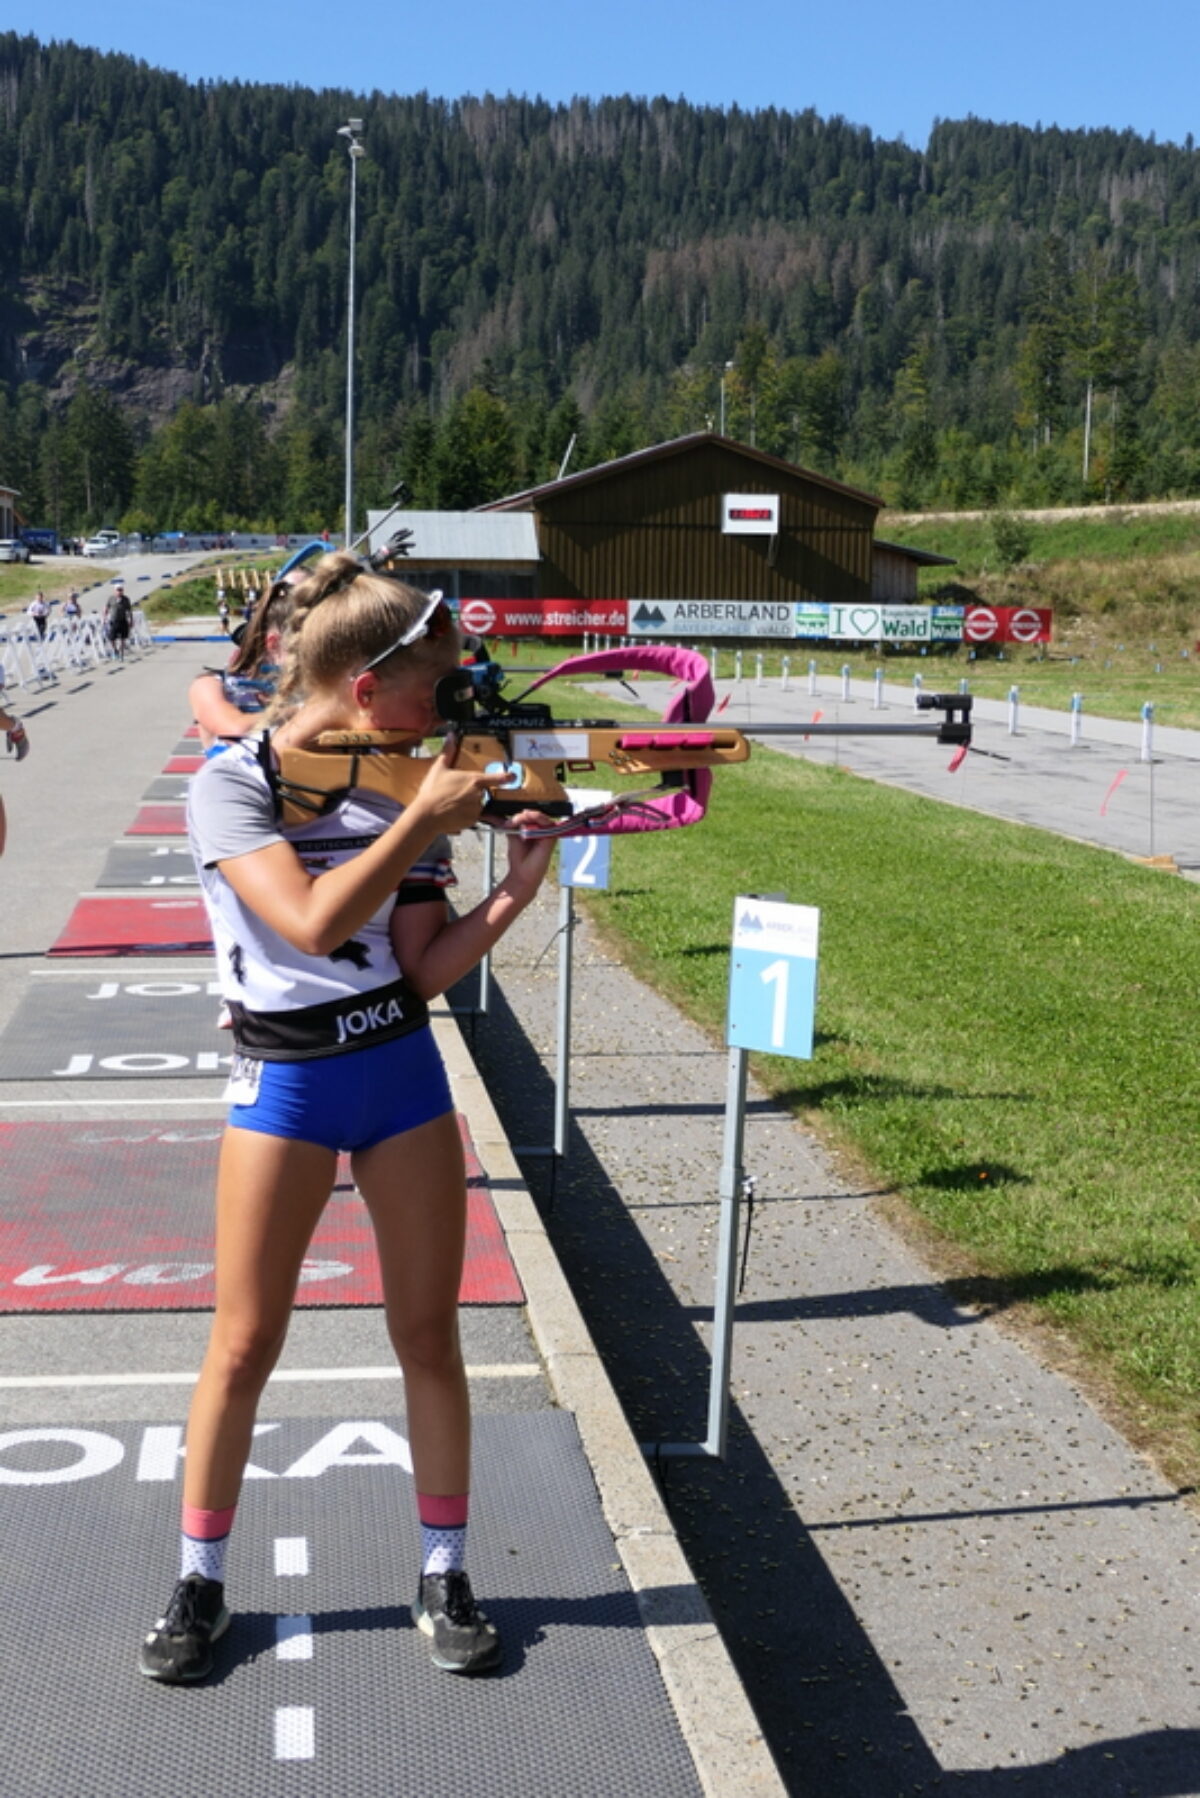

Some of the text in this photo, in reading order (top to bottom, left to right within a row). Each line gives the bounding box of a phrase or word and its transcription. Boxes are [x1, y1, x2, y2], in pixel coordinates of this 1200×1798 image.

[504, 610, 625, 626] www.streicher.de
[674, 603, 790, 620] ARBERLAND
[882, 620, 927, 636] Wald
[572, 835, 599, 884] 2
[336, 998, 403, 1044] JOKA
[760, 959, 789, 1048] 1
[0, 1422, 414, 1485] OKA
